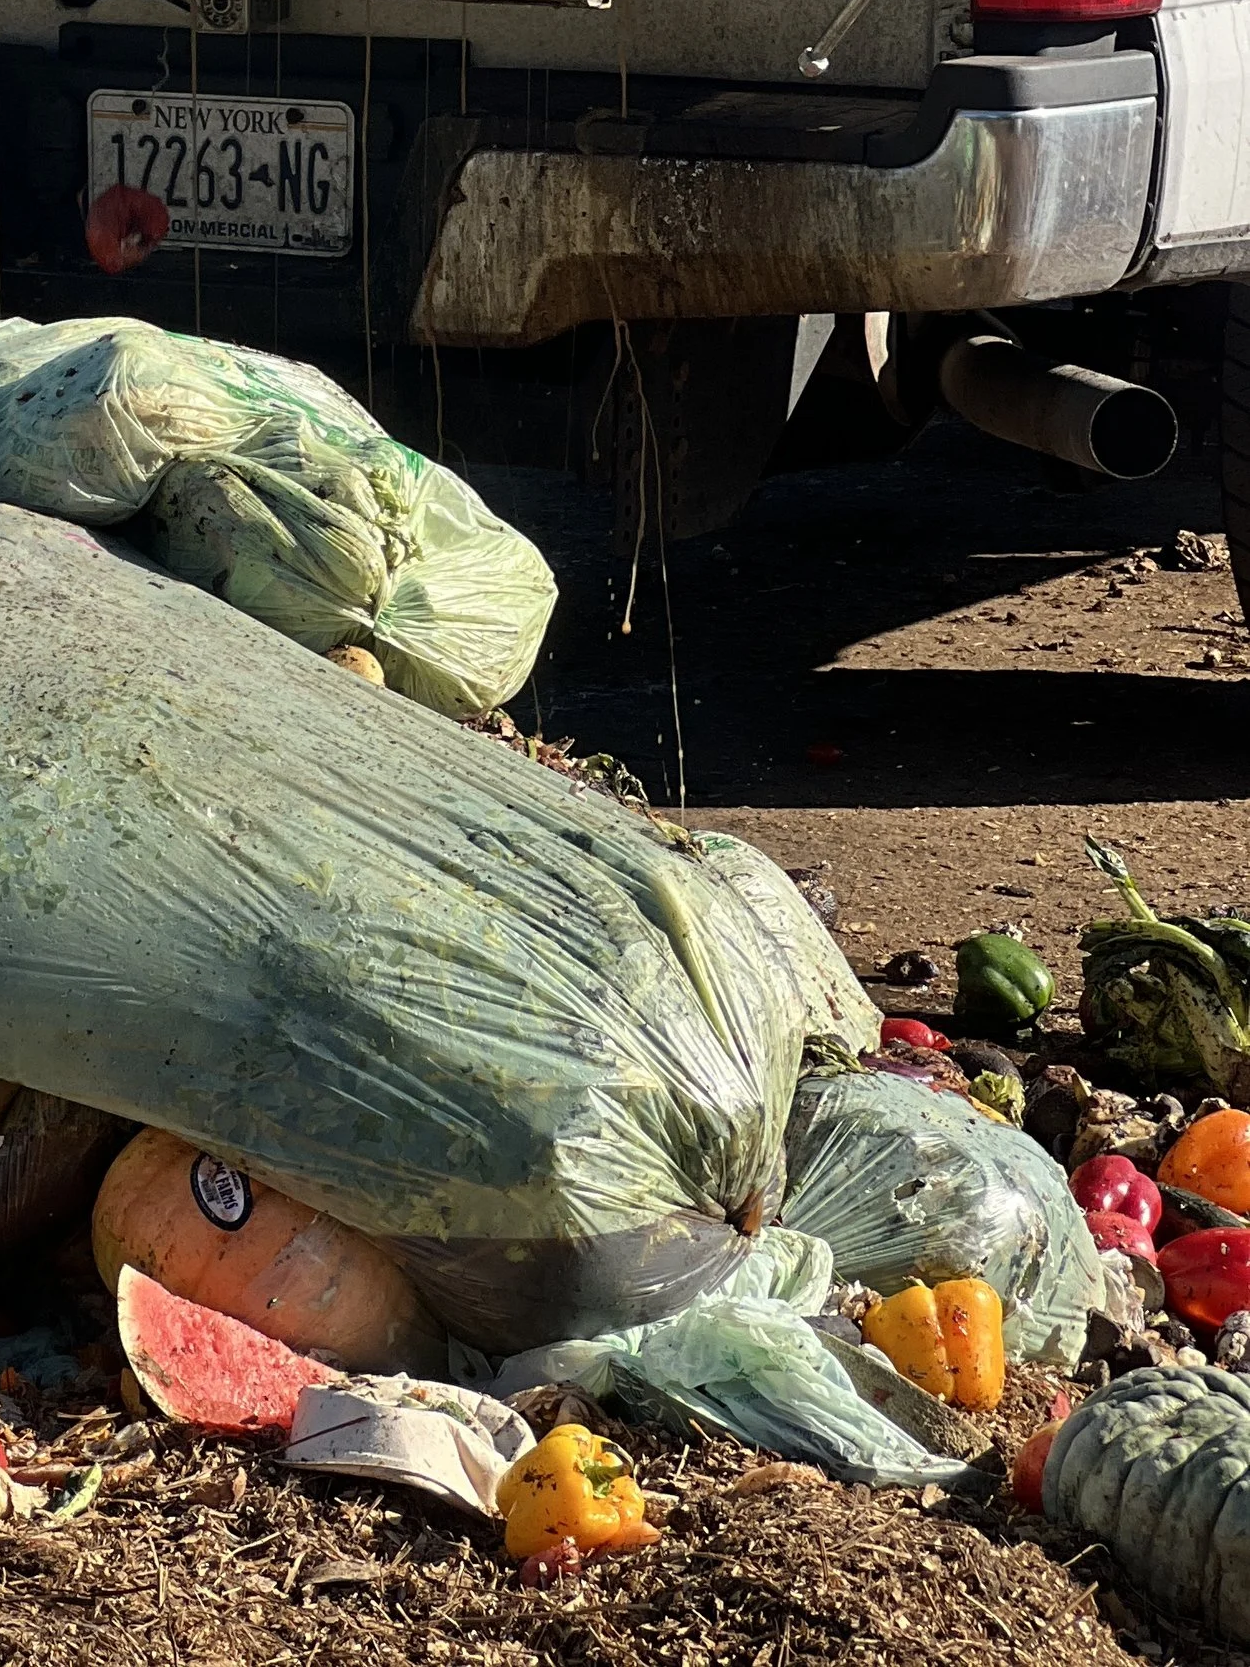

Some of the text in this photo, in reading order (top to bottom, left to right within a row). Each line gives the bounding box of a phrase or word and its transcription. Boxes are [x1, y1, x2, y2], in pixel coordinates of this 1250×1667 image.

[153, 104, 286, 135] NEW YORK
[278, 139, 331, 215] NG
[167, 218, 279, 241] OMMERCIAL
[216, 1177, 238, 1209] FARMS
